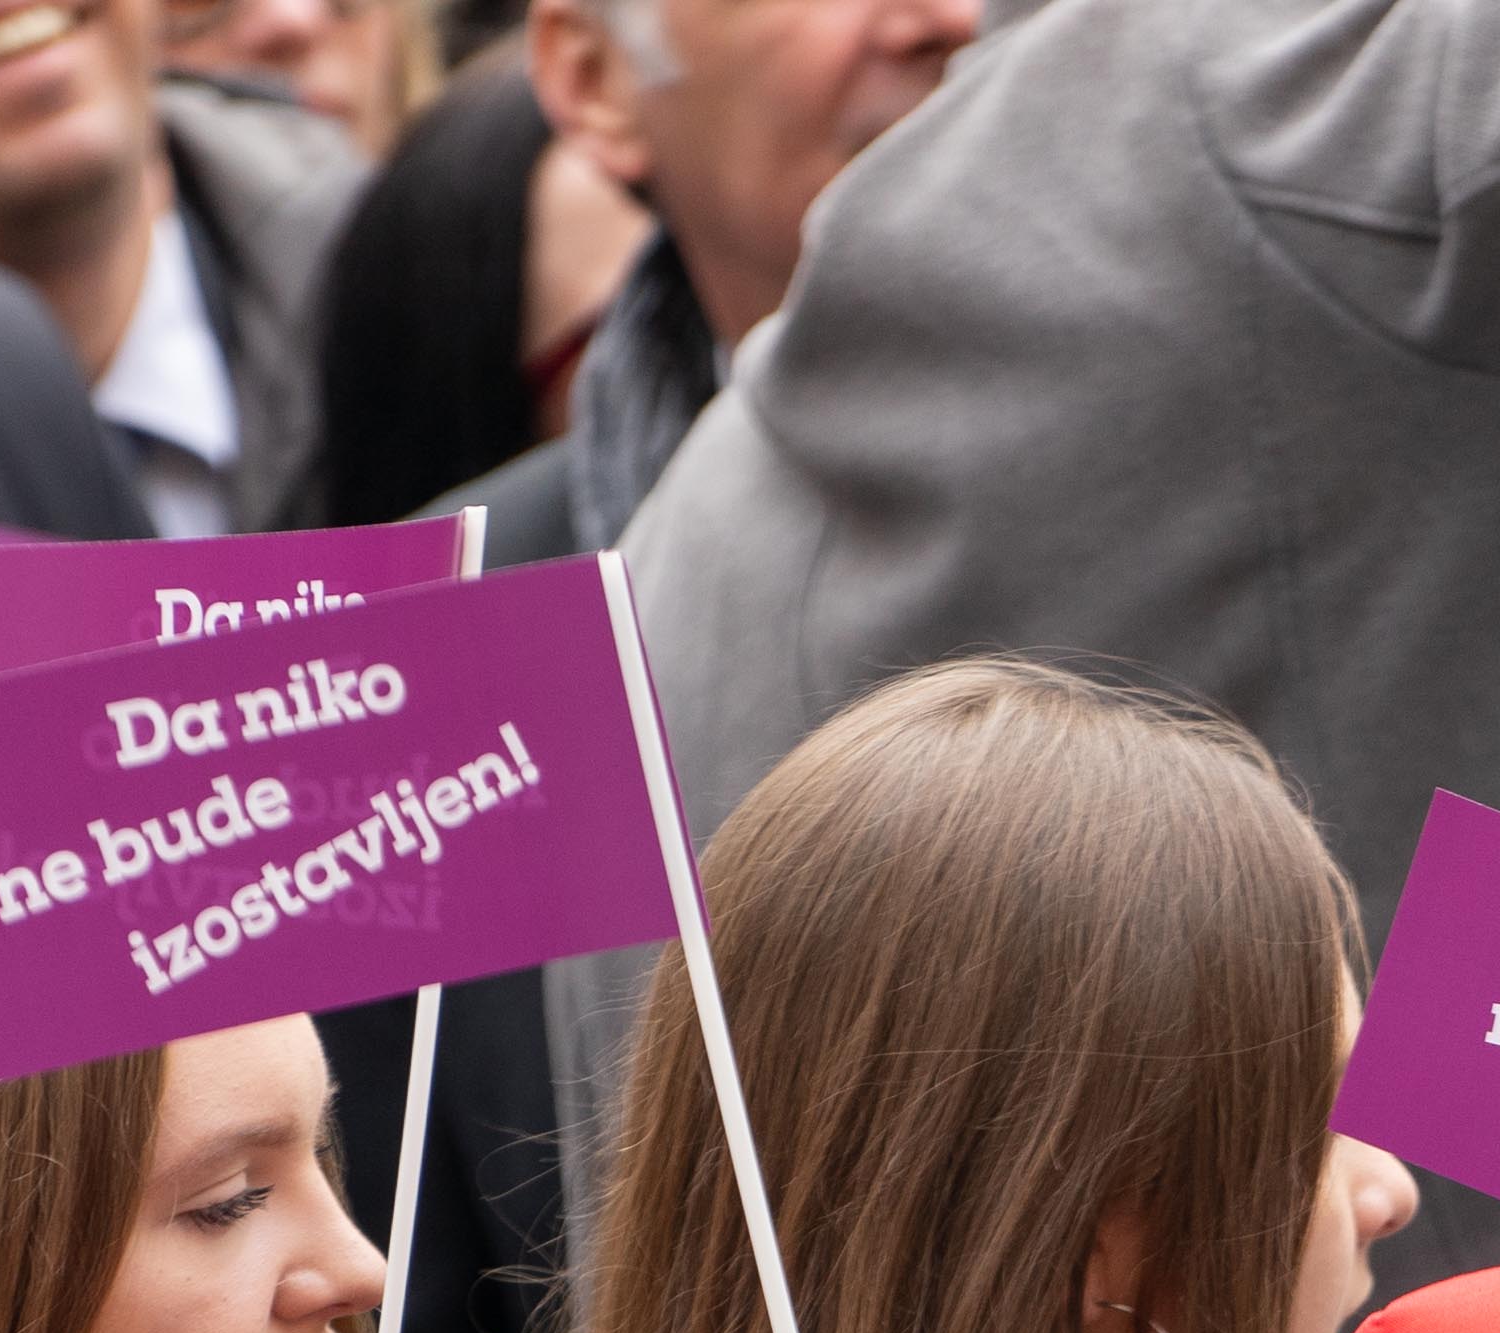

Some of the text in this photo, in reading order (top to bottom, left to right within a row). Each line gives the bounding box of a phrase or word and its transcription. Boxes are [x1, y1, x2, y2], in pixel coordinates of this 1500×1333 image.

[155, 588, 243, 647] Da
[106, 658, 406, 769] Da niko
[87, 775, 292, 886] bude
[128, 721, 540, 995] izostavljen!
